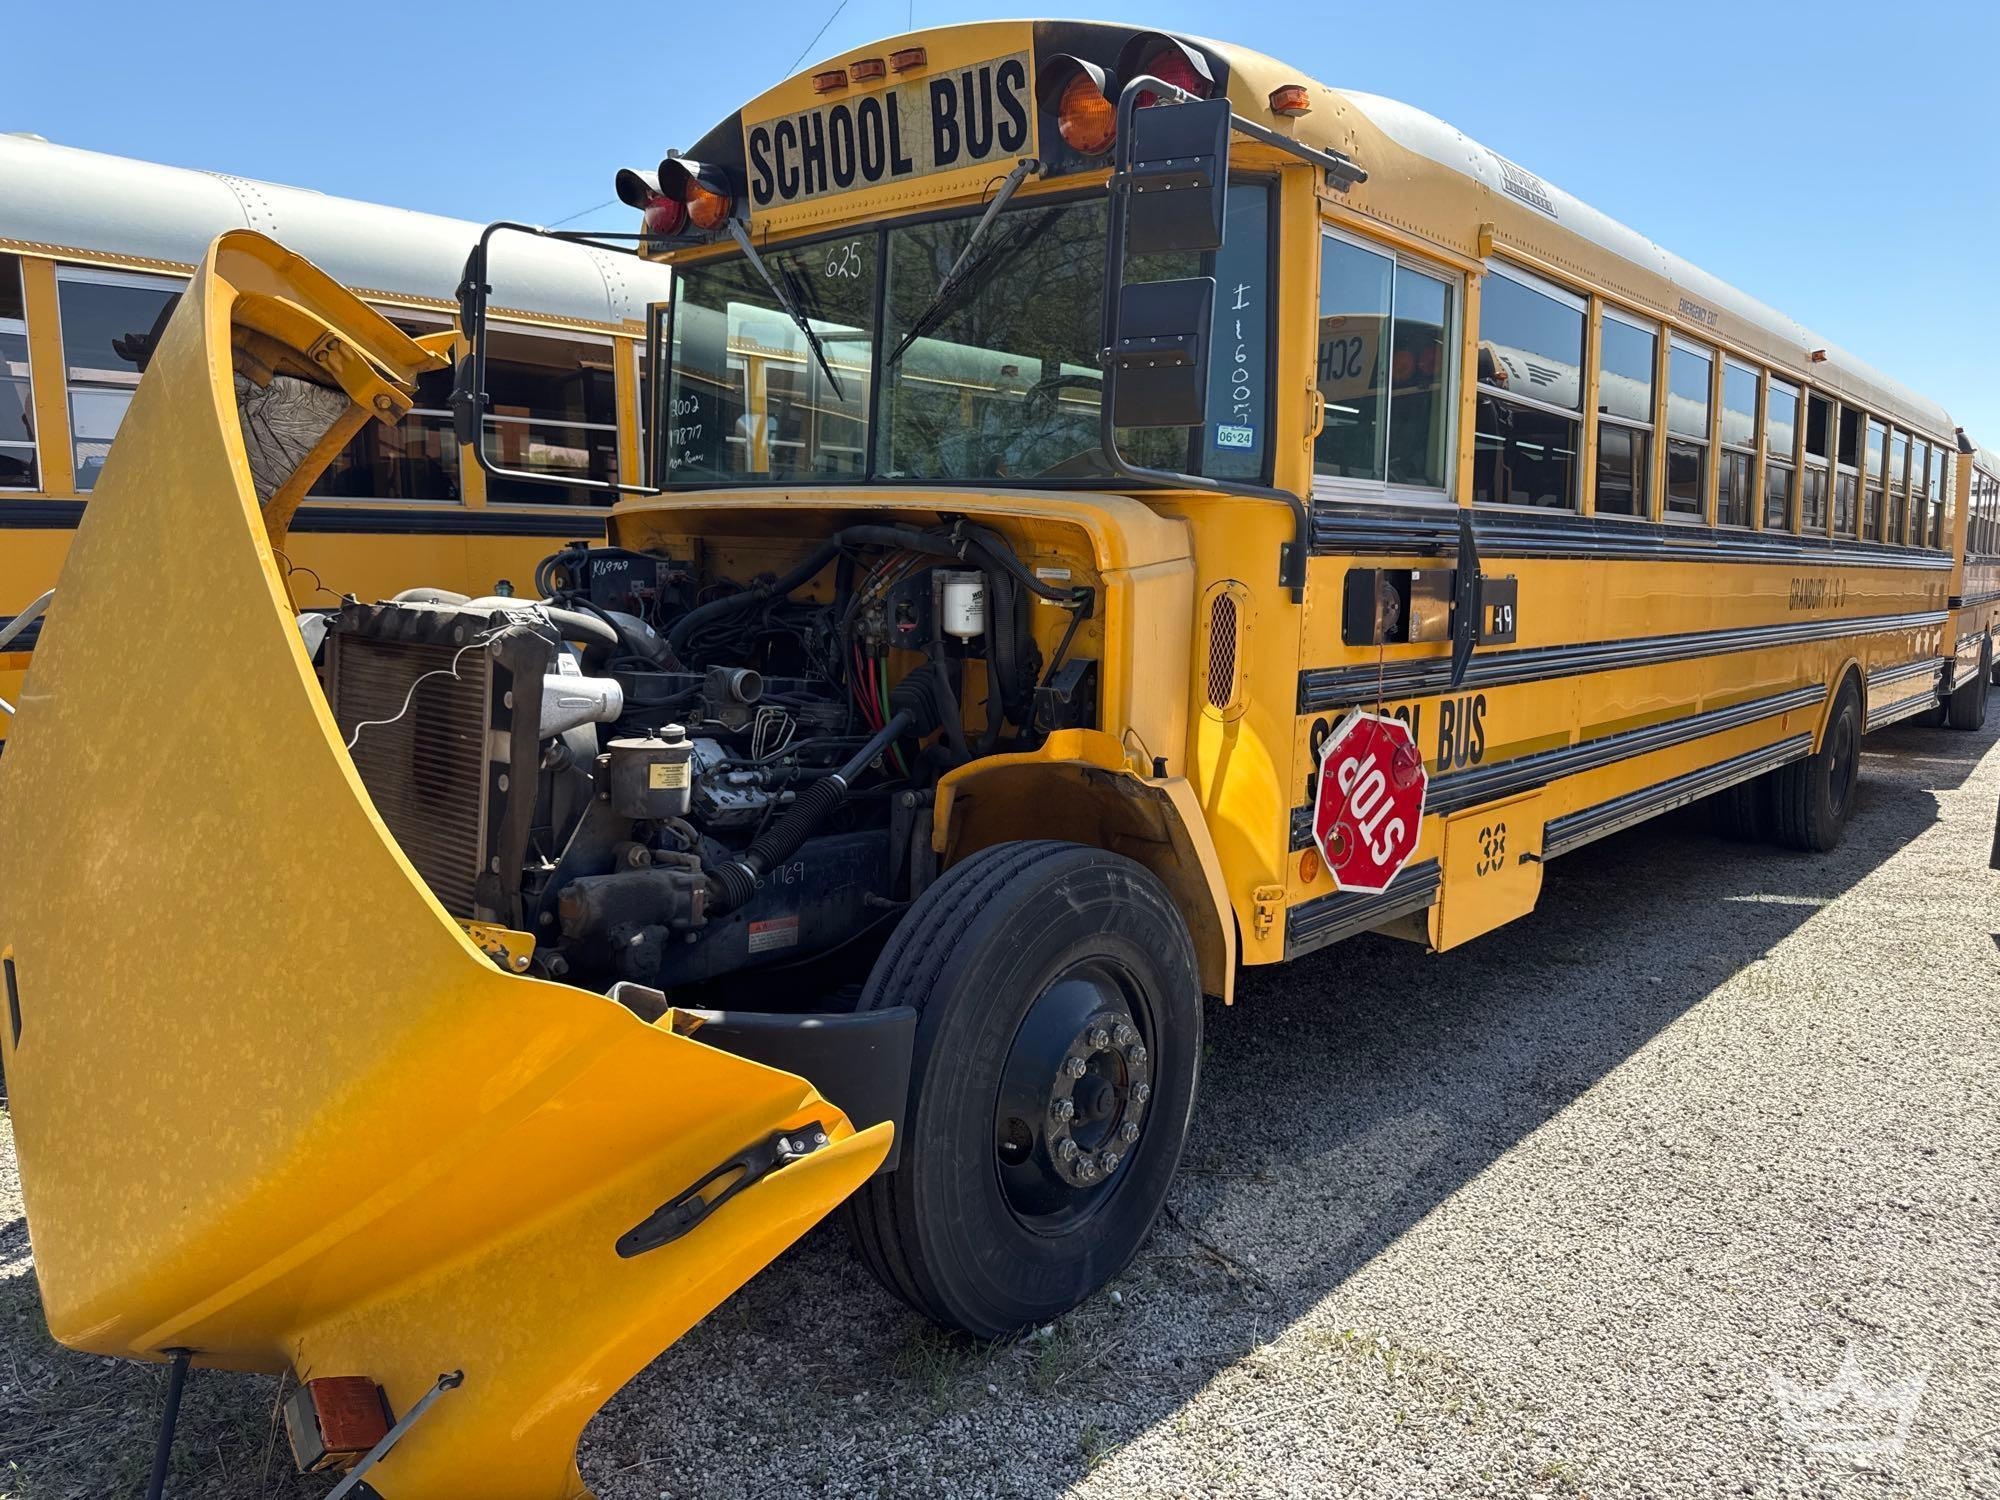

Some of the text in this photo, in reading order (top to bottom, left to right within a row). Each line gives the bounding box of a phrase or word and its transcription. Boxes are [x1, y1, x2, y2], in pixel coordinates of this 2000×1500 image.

[750, 59, 1028, 205] SCHOOL BUS
[825, 242, 862, 278] 625
[1678, 297, 1719, 326] EMERGENCY EXIT
[670, 395, 700, 417] 2002
[1437, 694, 1486, 772] BUS
[1337, 752, 1405, 866] STOP
[1476, 822, 1506, 877] 38
